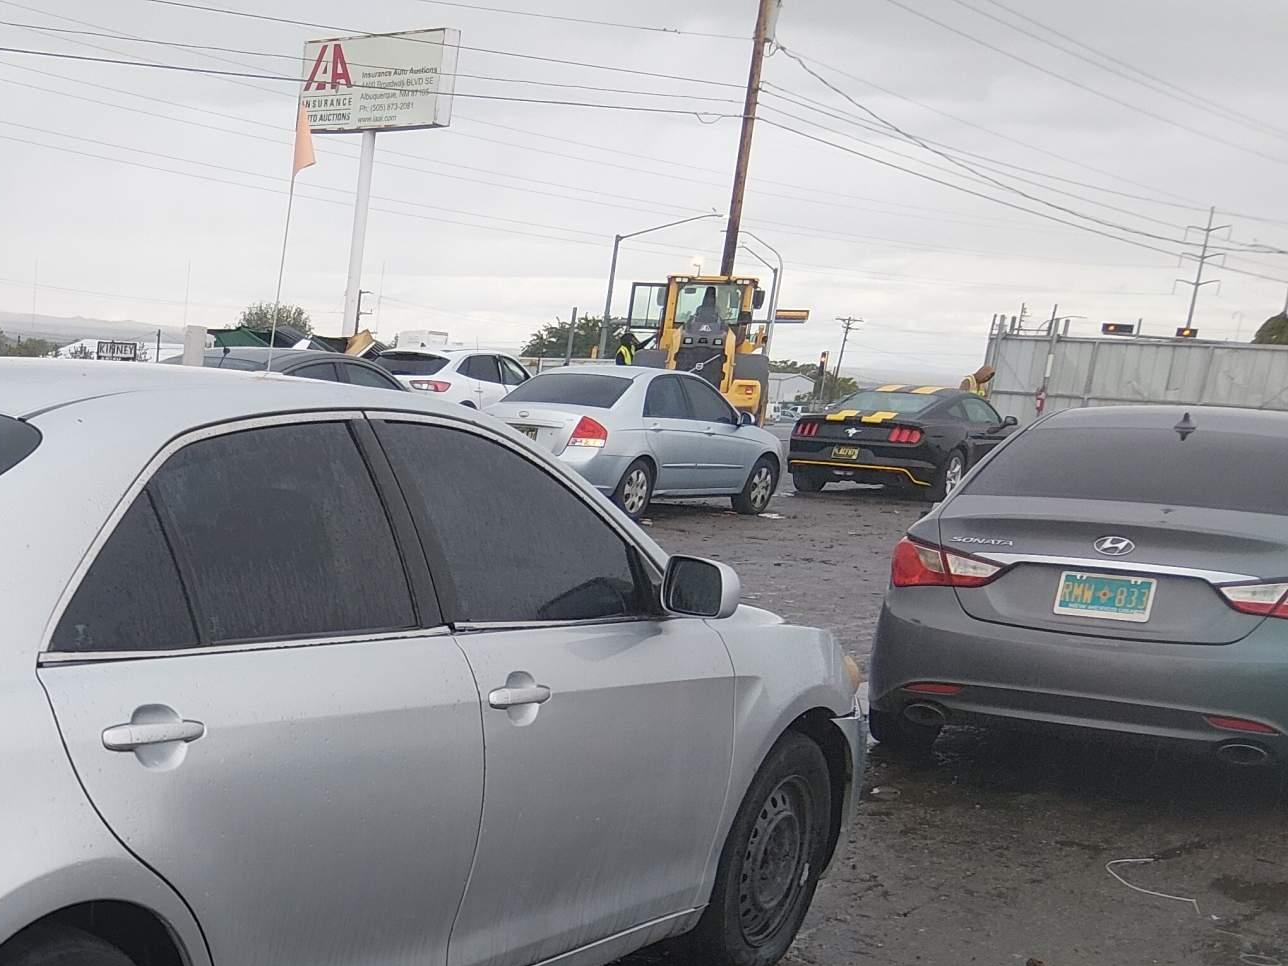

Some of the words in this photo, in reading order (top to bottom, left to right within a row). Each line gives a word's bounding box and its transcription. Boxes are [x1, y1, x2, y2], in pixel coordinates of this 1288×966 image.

[406, 77, 423, 86] BLVD
[318, 112, 351, 122] AUCTIONS
[951, 535, 1013, 546] SONATA
